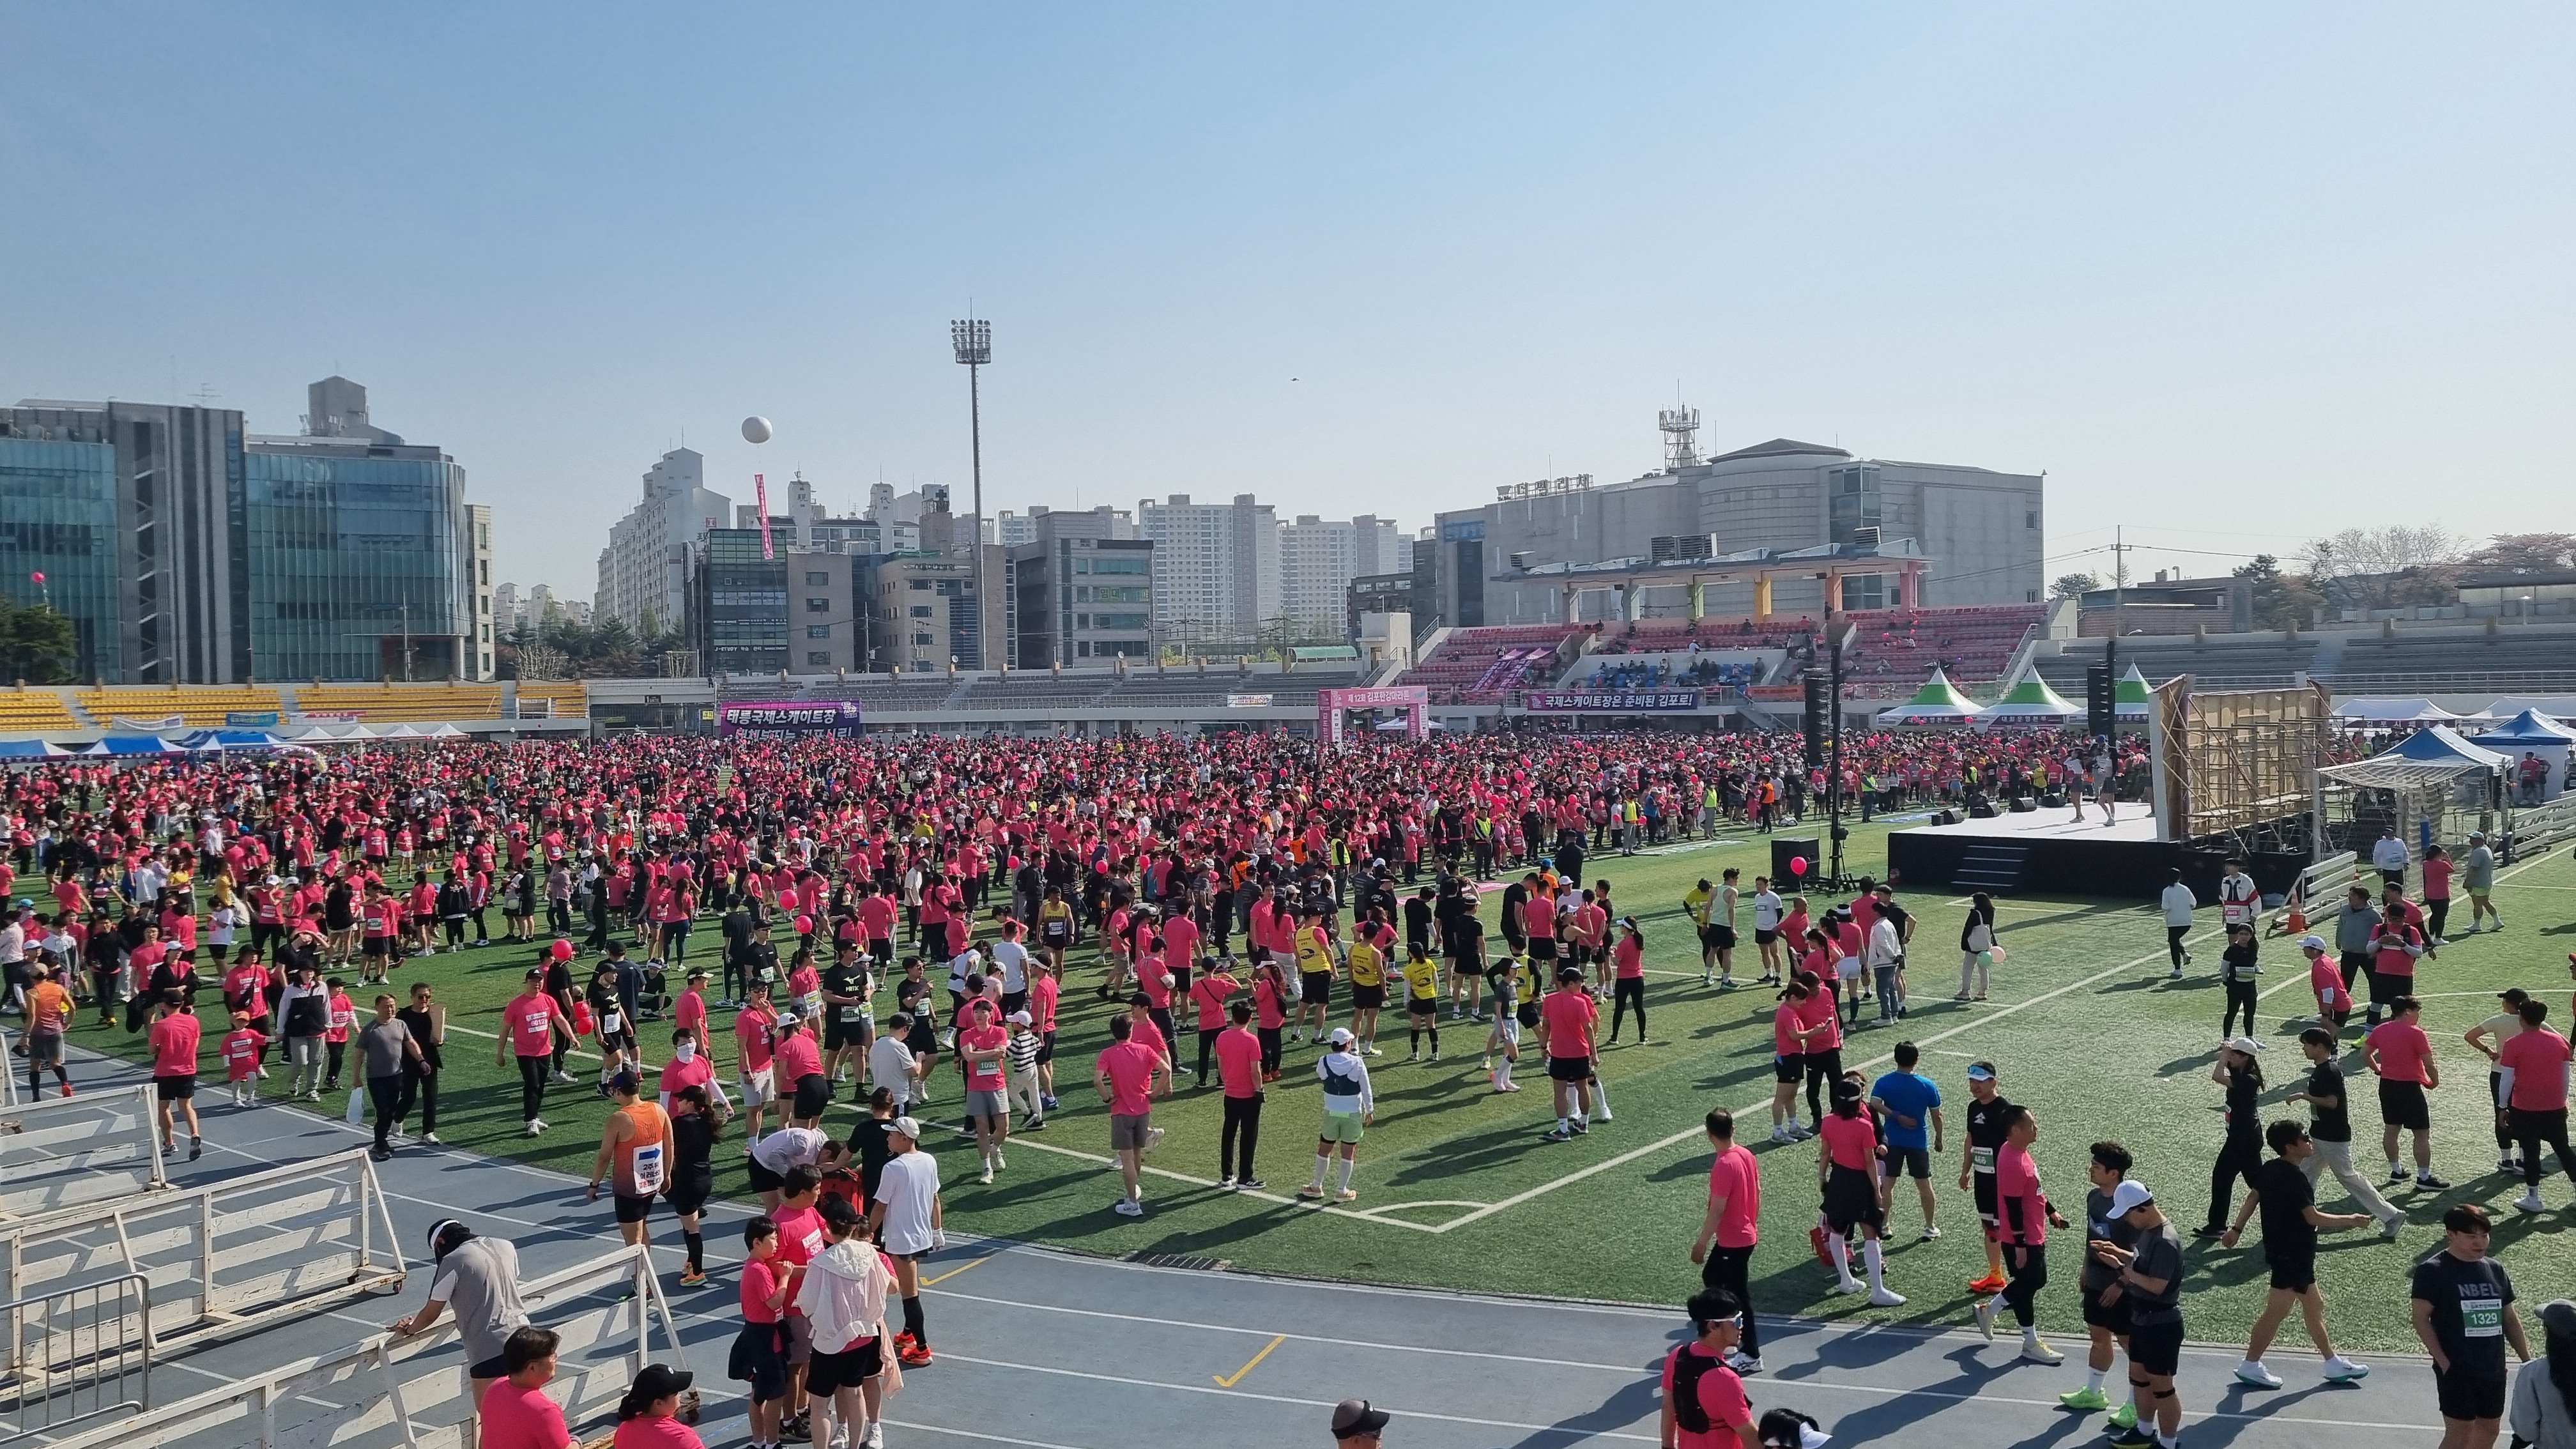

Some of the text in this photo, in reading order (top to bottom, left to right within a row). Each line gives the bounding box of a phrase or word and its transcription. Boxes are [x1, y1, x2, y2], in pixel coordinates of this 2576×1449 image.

[1347, 690, 1410, 703] 제 12회 김포한강마라톤
[1544, 693, 1693, 708] 국제스케이트장은 준비된 김포로!
[726, 709, 836, 724] 태릉국제스케이트장
[981, 1061, 997, 1070] 1093
[2457, 1282, 2500, 1298] NBEL
[2471, 1313, 2498, 1325] 1329
